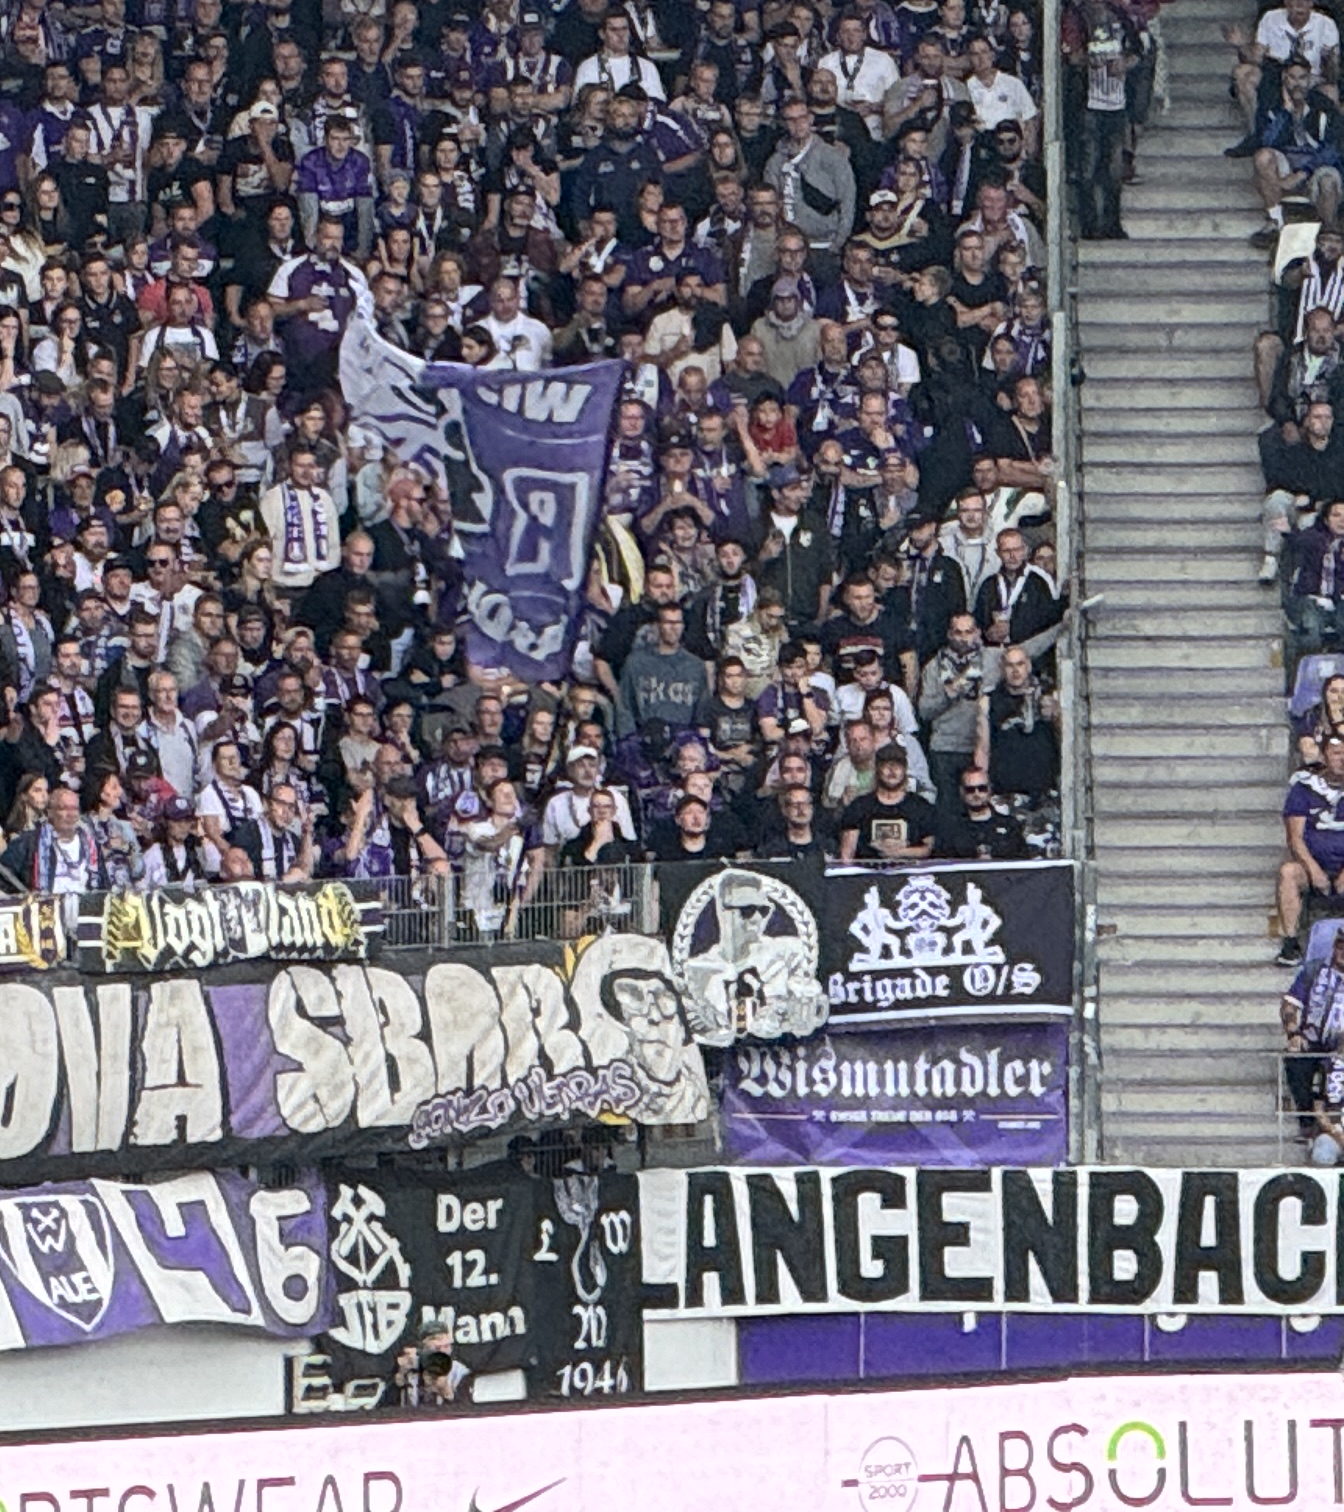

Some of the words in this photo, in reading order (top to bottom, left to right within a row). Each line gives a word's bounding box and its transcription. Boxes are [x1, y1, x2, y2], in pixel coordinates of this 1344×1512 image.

[828, 967, 951, 1008] Brigade
[737, 1040, 1054, 1099] Wismutadler
[436, 1192, 504, 1233] Der
[641, 1169, 1344, 1306] LANGENBAC
[48, 1270, 103, 1305] AUE
[445, 1248, 499, 1289] 12.
